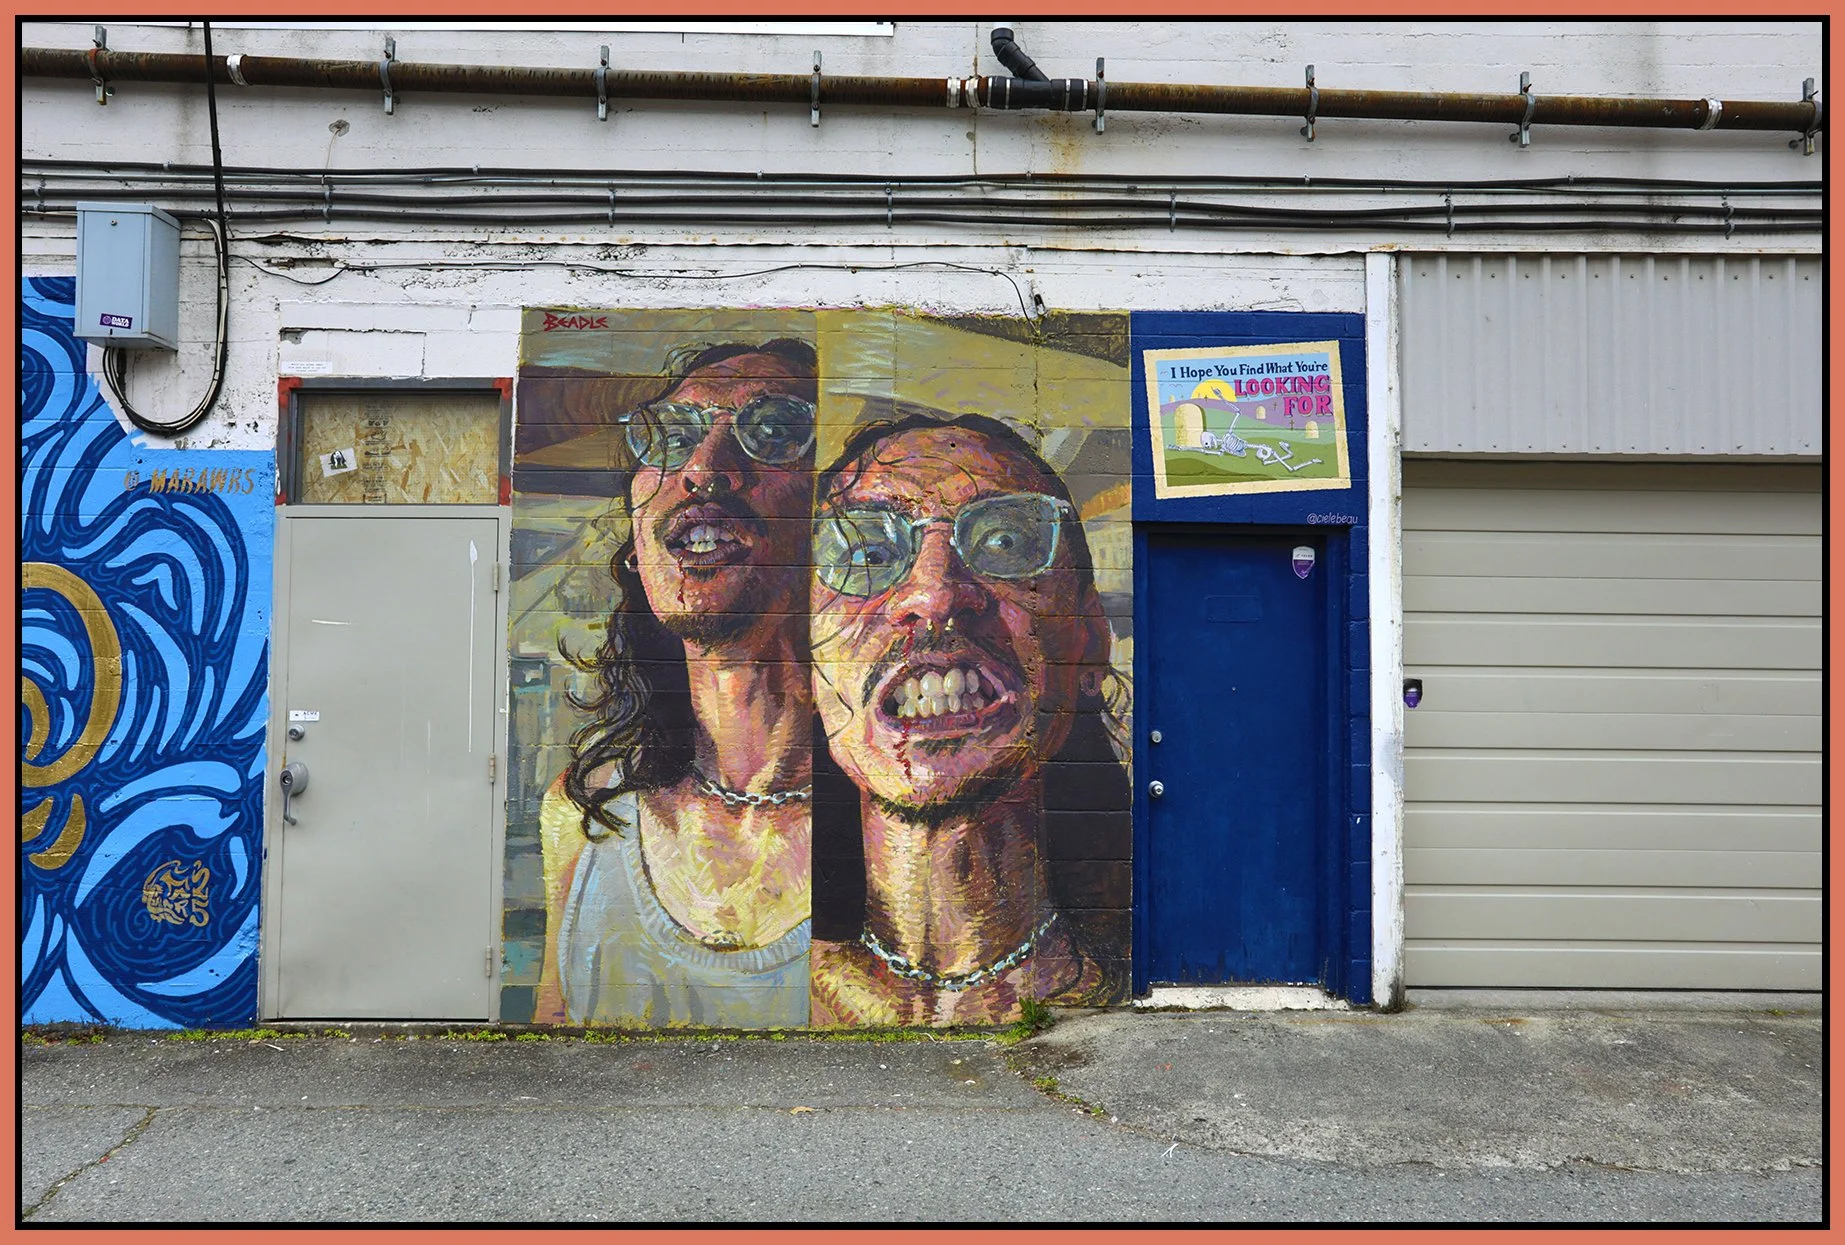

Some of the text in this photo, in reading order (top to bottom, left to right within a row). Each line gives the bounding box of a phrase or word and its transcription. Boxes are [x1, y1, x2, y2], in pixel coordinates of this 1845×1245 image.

[543, 312, 609, 331] BEADLE
[1170, 360, 1328, 381] I Hope You Find What You're
[1234, 375, 1331, 398] LOOKING
[1283, 395, 1334, 417] FOR
[1306, 512, 1359, 524] @cielebeau
